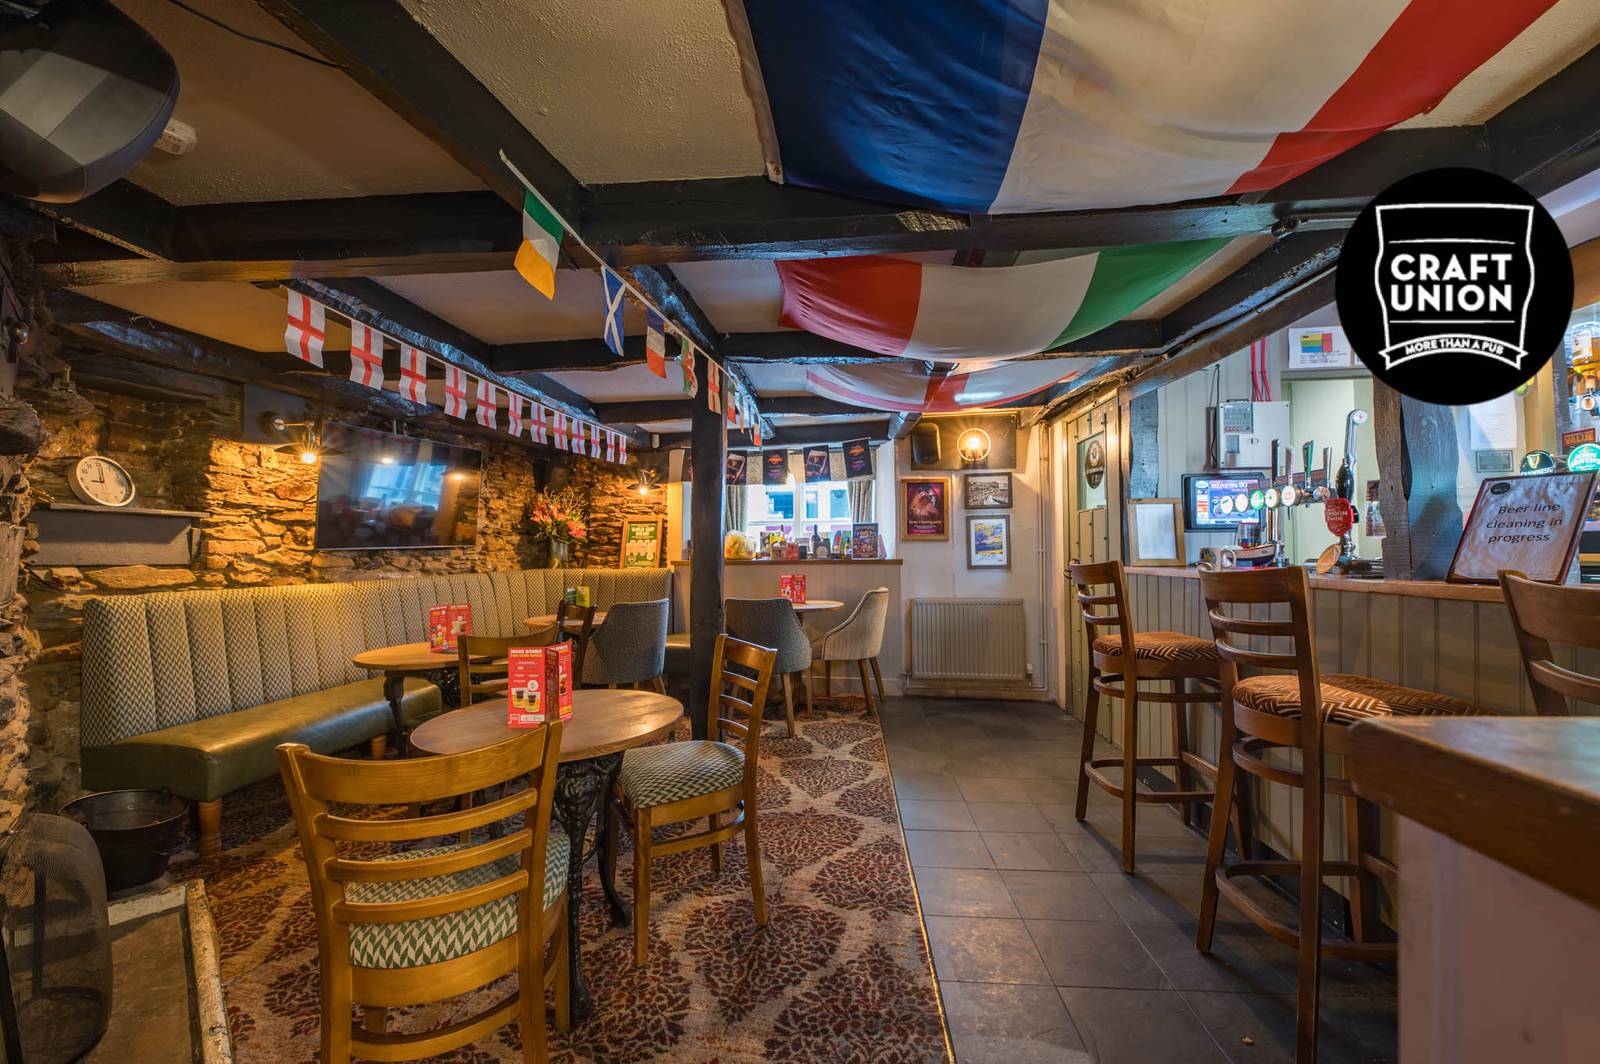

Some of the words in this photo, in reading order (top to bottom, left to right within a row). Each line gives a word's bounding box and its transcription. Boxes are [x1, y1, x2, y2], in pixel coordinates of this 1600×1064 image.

[1498, 505, 1529, 514] Beer
[1533, 503, 1561, 512] line
[1486, 518, 1546, 529] cleaning
[1550, 517, 1563, 526] in
[1488, 533, 1551, 544] progress
